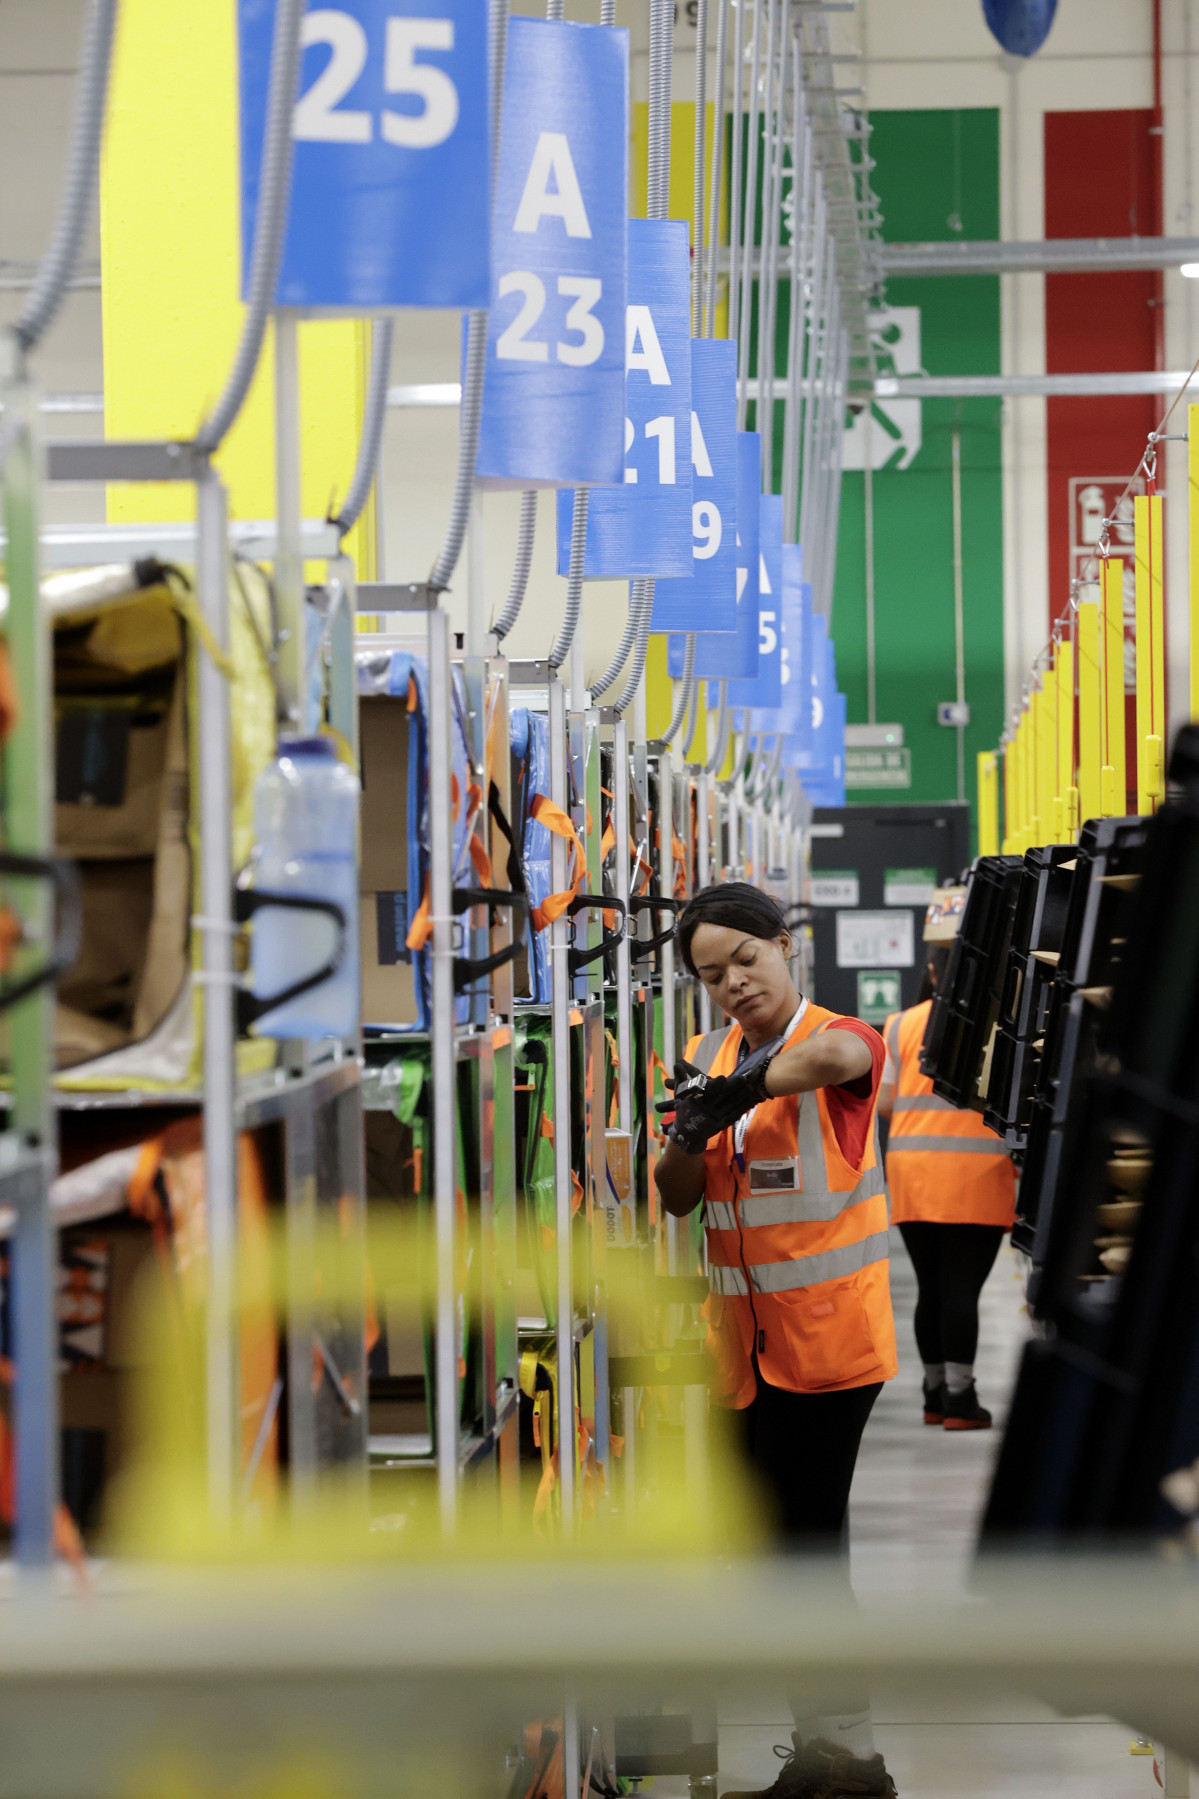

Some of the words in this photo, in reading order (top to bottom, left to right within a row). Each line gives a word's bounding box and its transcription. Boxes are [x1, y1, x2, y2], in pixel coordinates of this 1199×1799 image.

[292, 8, 460, 149] 25
[512, 132, 592, 239] A
[496, 270, 605, 367] 23
[625, 305, 671, 385] A
[692, 500, 722, 560] 9
[759, 611, 777, 655] 5
